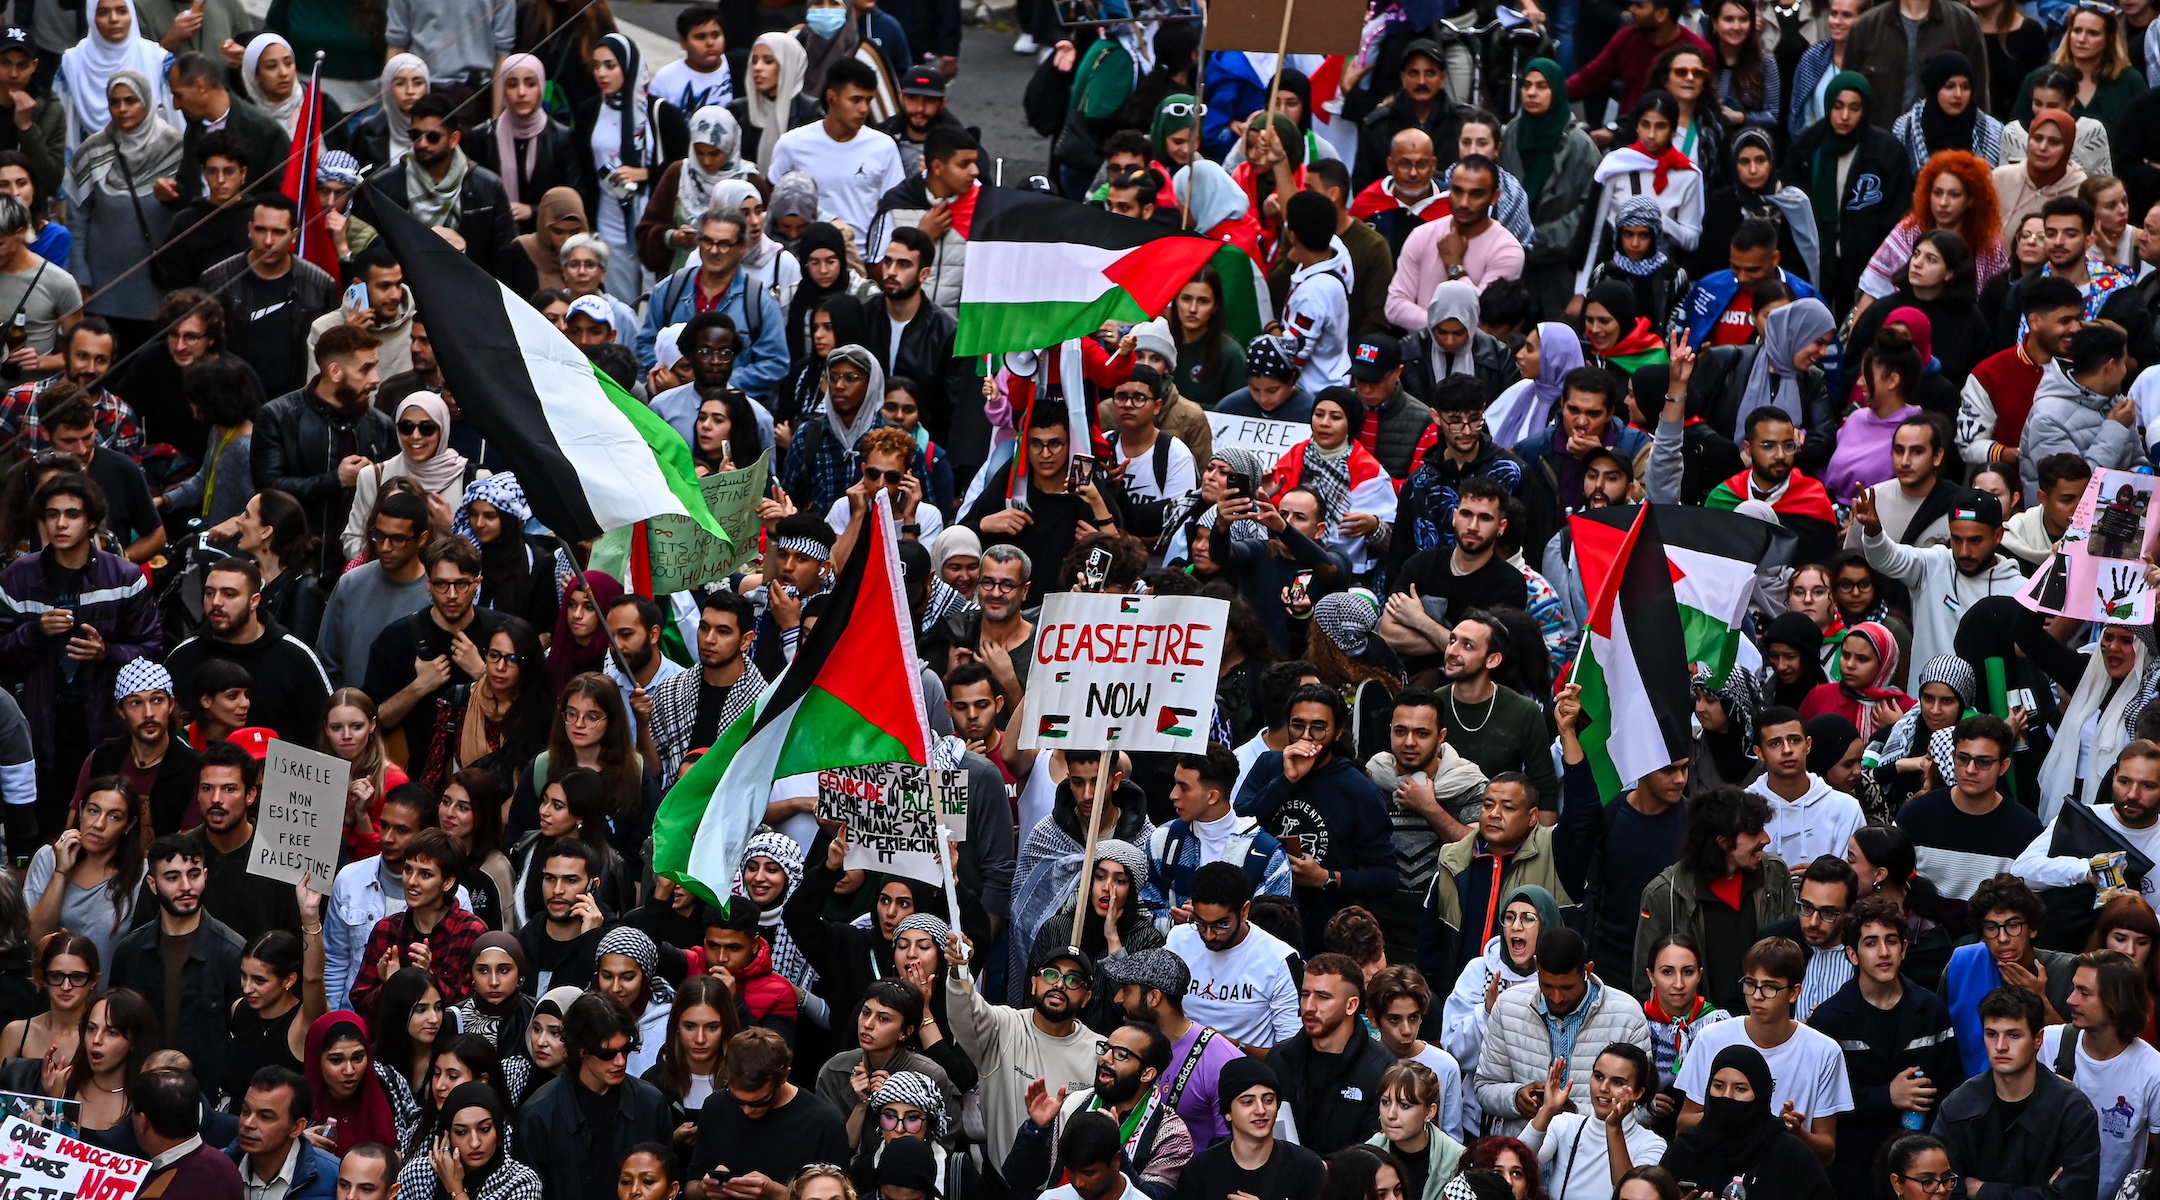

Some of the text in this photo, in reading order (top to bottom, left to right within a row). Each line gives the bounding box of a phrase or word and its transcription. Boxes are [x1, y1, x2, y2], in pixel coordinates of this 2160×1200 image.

[1238, 420, 1296, 447] FREE
[658, 541, 689, 554] ITS
[1037, 623, 1213, 667] CEASEFIRE
[1085, 682, 1152, 719] NOW
[274, 756, 331, 785] ISRAELE
[941, 769, 962, 787] OF
[289, 791, 312, 807] NON
[888, 787, 901, 809] IN
[903, 789, 968, 815] PALETINE
[937, 785, 968, 801] THE
[269, 804, 318, 828] ESISTE
[817, 799, 904, 836] PALESTINIANS
[867, 800, 901, 821] HOW
[1286, 799, 1326, 829] SEVENTY
[279, 832, 311, 847] FREE
[846, 827, 940, 854] EXPERIENCIN
[261, 848, 331, 880] PALESTINE
[878, 850, 896, 864] IT
[1175, 1056, 1197, 1091] adidas
[9, 1123, 149, 1176] ONE HOLOCAUST
[20, 1153, 70, 1179] DOES
